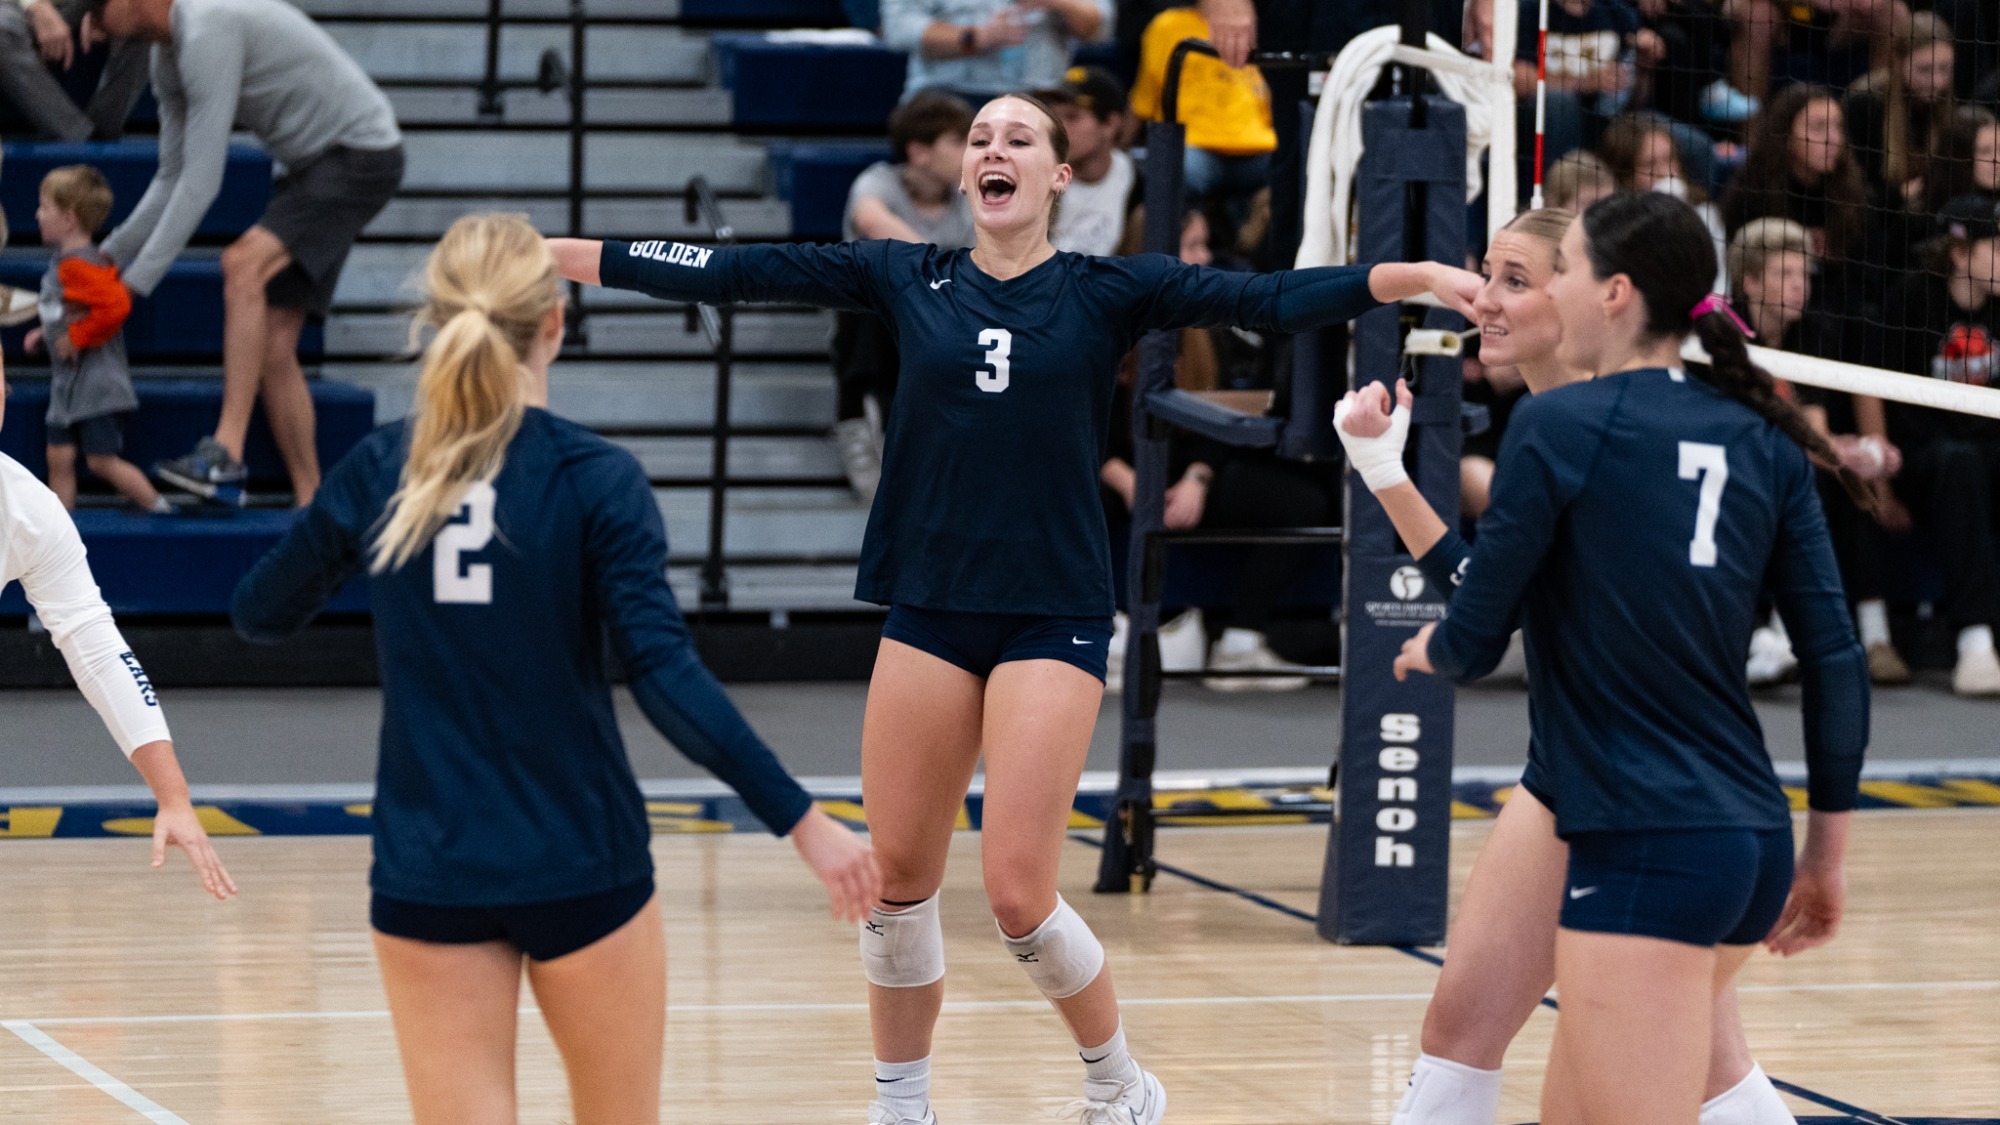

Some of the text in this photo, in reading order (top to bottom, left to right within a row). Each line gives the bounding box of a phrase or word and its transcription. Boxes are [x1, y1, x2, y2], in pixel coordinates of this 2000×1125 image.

[628, 240, 714, 269] GOLDEN
[975, 328, 1013, 393] 3
[1678, 440, 1729, 568] 7
[433, 480, 498, 604] 2
[119, 651, 158, 707] EARS
